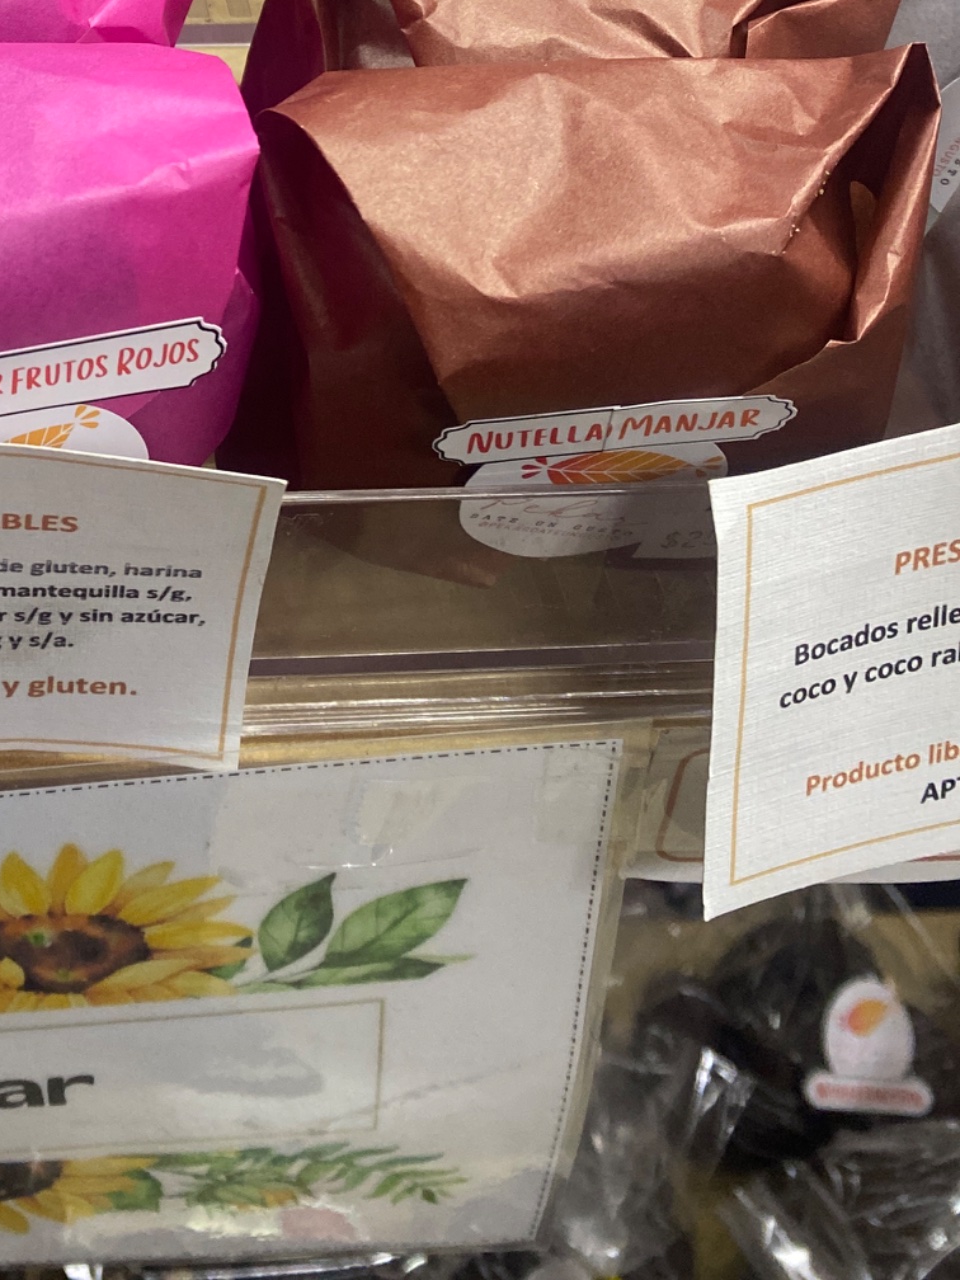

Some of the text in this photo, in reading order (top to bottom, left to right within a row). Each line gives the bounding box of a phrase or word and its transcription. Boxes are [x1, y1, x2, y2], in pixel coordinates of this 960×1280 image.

[10, 355, 108, 396] FRUTOS
[116, 338, 200, 377] ROJOS
[466, 408, 761, 455] NUTELLA MANJAR
[30, 560, 117, 578] gluten,
[124, 563, 203, 579] harina
[146, 586, 192, 603] s/g,
[14, 607, 53, 626] s/g
[58, 610, 74, 626] y
[80, 608, 114, 623] sin
[121, 609, 207, 627] azúcar,
[8, 635, 23, 651] y
[28, 633, 74, 650] s/a.
[794, 623, 899, 666] Bocados
[1, 680, 20, 698] y
[27, 676, 138, 698] gluten.
[779, 677, 837, 709] coco
[843, 671, 858, 694] y
[864, 655, 923, 683] coco
[806, 752, 921, 796] Producto
